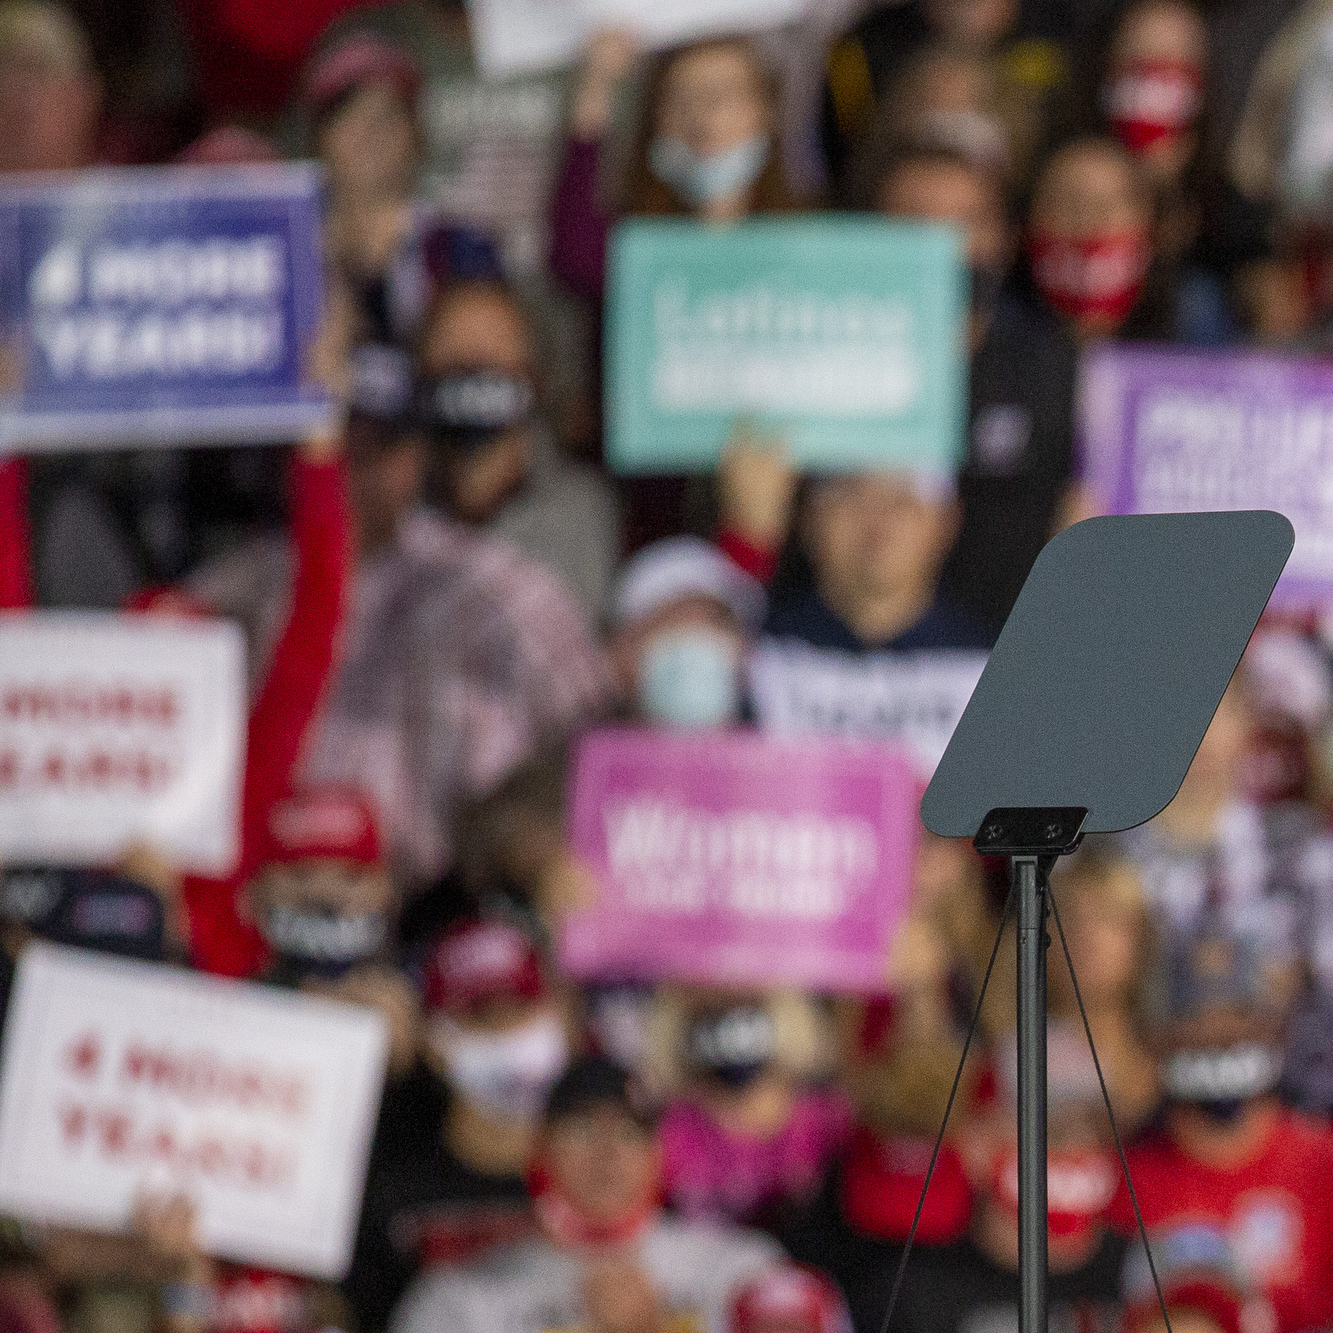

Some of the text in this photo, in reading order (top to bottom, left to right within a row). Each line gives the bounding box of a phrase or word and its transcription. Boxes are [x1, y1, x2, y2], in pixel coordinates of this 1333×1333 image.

[90, 236, 283, 299] MORE
[46, 312, 280, 380] YEARS!
[65, 1031, 308, 1114] 4 MORE
[57, 1103, 302, 1187] YEARS!
